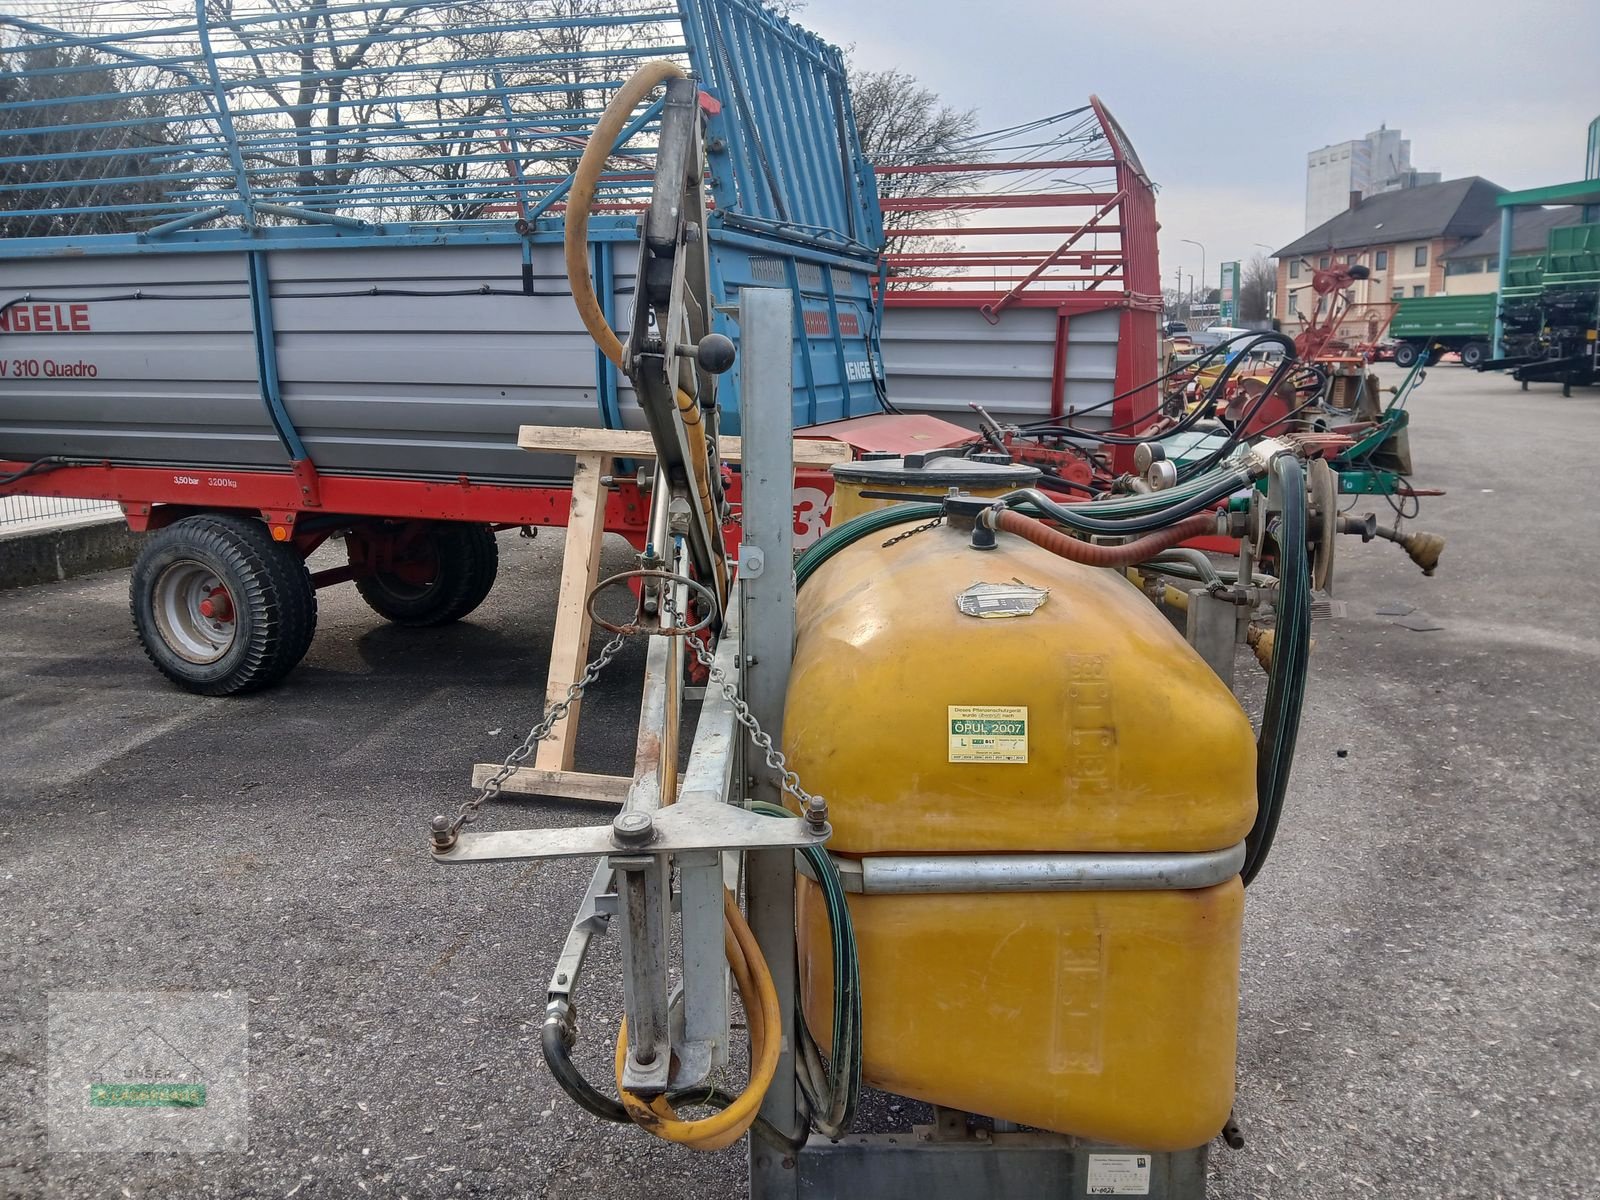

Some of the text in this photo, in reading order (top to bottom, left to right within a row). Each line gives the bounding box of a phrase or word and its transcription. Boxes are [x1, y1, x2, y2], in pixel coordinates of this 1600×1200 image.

[12, 359, 40, 377] 310
[43, 359, 98, 378] Quadro
[954, 721, 1022, 734] ÖPUL 2007
